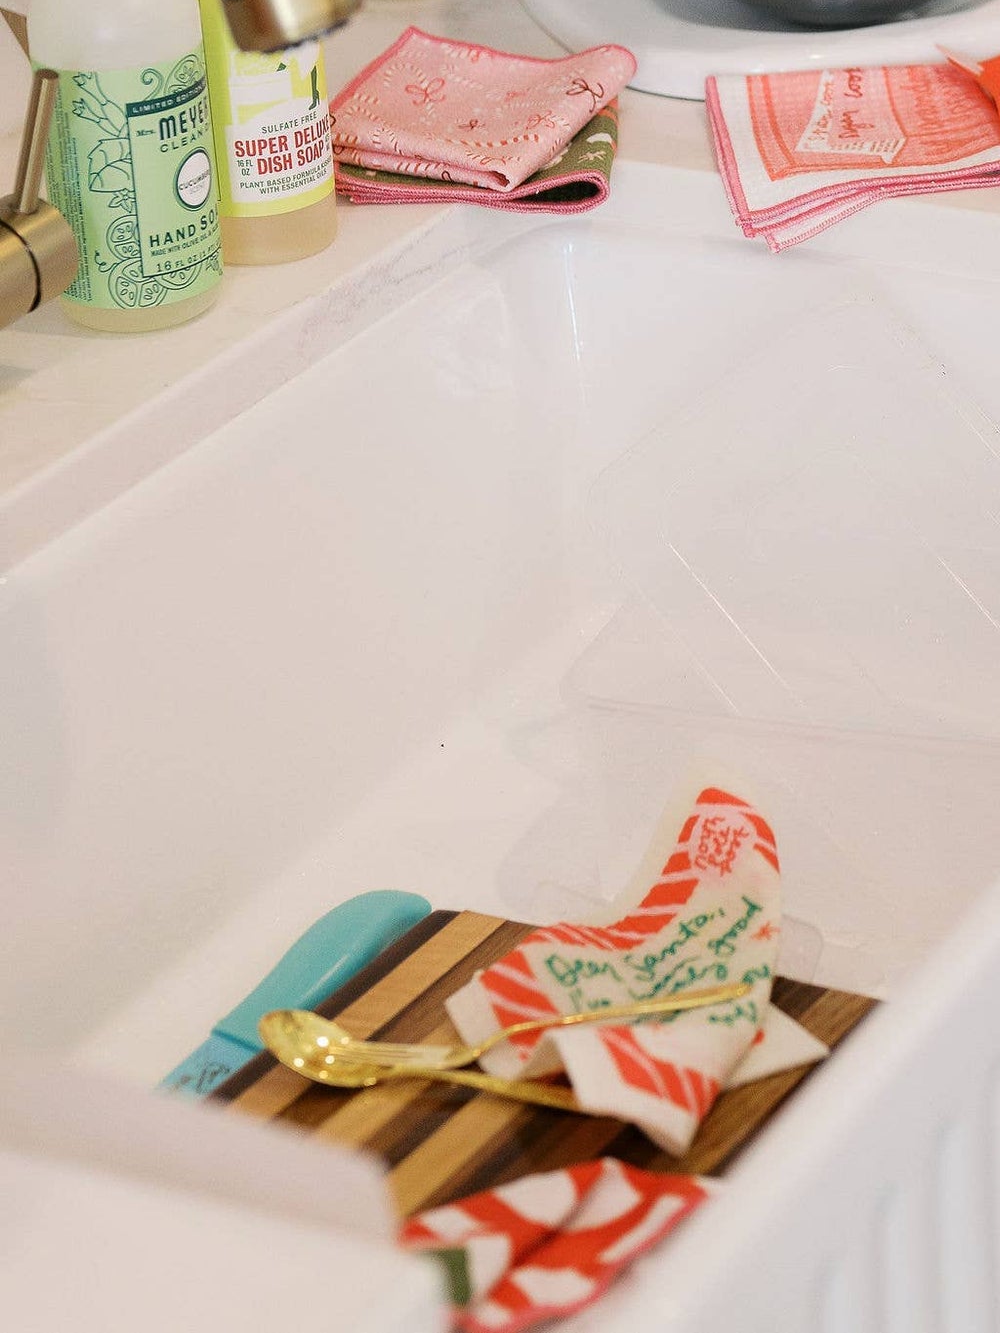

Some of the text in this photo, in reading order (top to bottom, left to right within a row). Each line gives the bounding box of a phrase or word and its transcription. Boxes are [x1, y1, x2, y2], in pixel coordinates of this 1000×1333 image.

[132, 98, 174, 113] LIMITED
[261, 111, 317, 135] SULFATE FREE
[160, 129, 203, 153] CLEAN
[234, 135, 289, 157] SUPER
[294, 114, 330, 148] DELUXE
[237, 159, 253, 168] 16 FL
[257, 153, 293, 175] DISH
[297, 139, 324, 166] SOAP
[240, 180, 264, 189] PLANT
[266, 176, 292, 186] BASED
[293, 165, 321, 181] FORMULA
[241, 168, 250, 176] OZ
[259, 186, 280, 194] WITH
[281, 176, 316, 191] ESSENTIAL
[149, 224, 196, 247] HAND
[156, 260, 172, 272] 16
